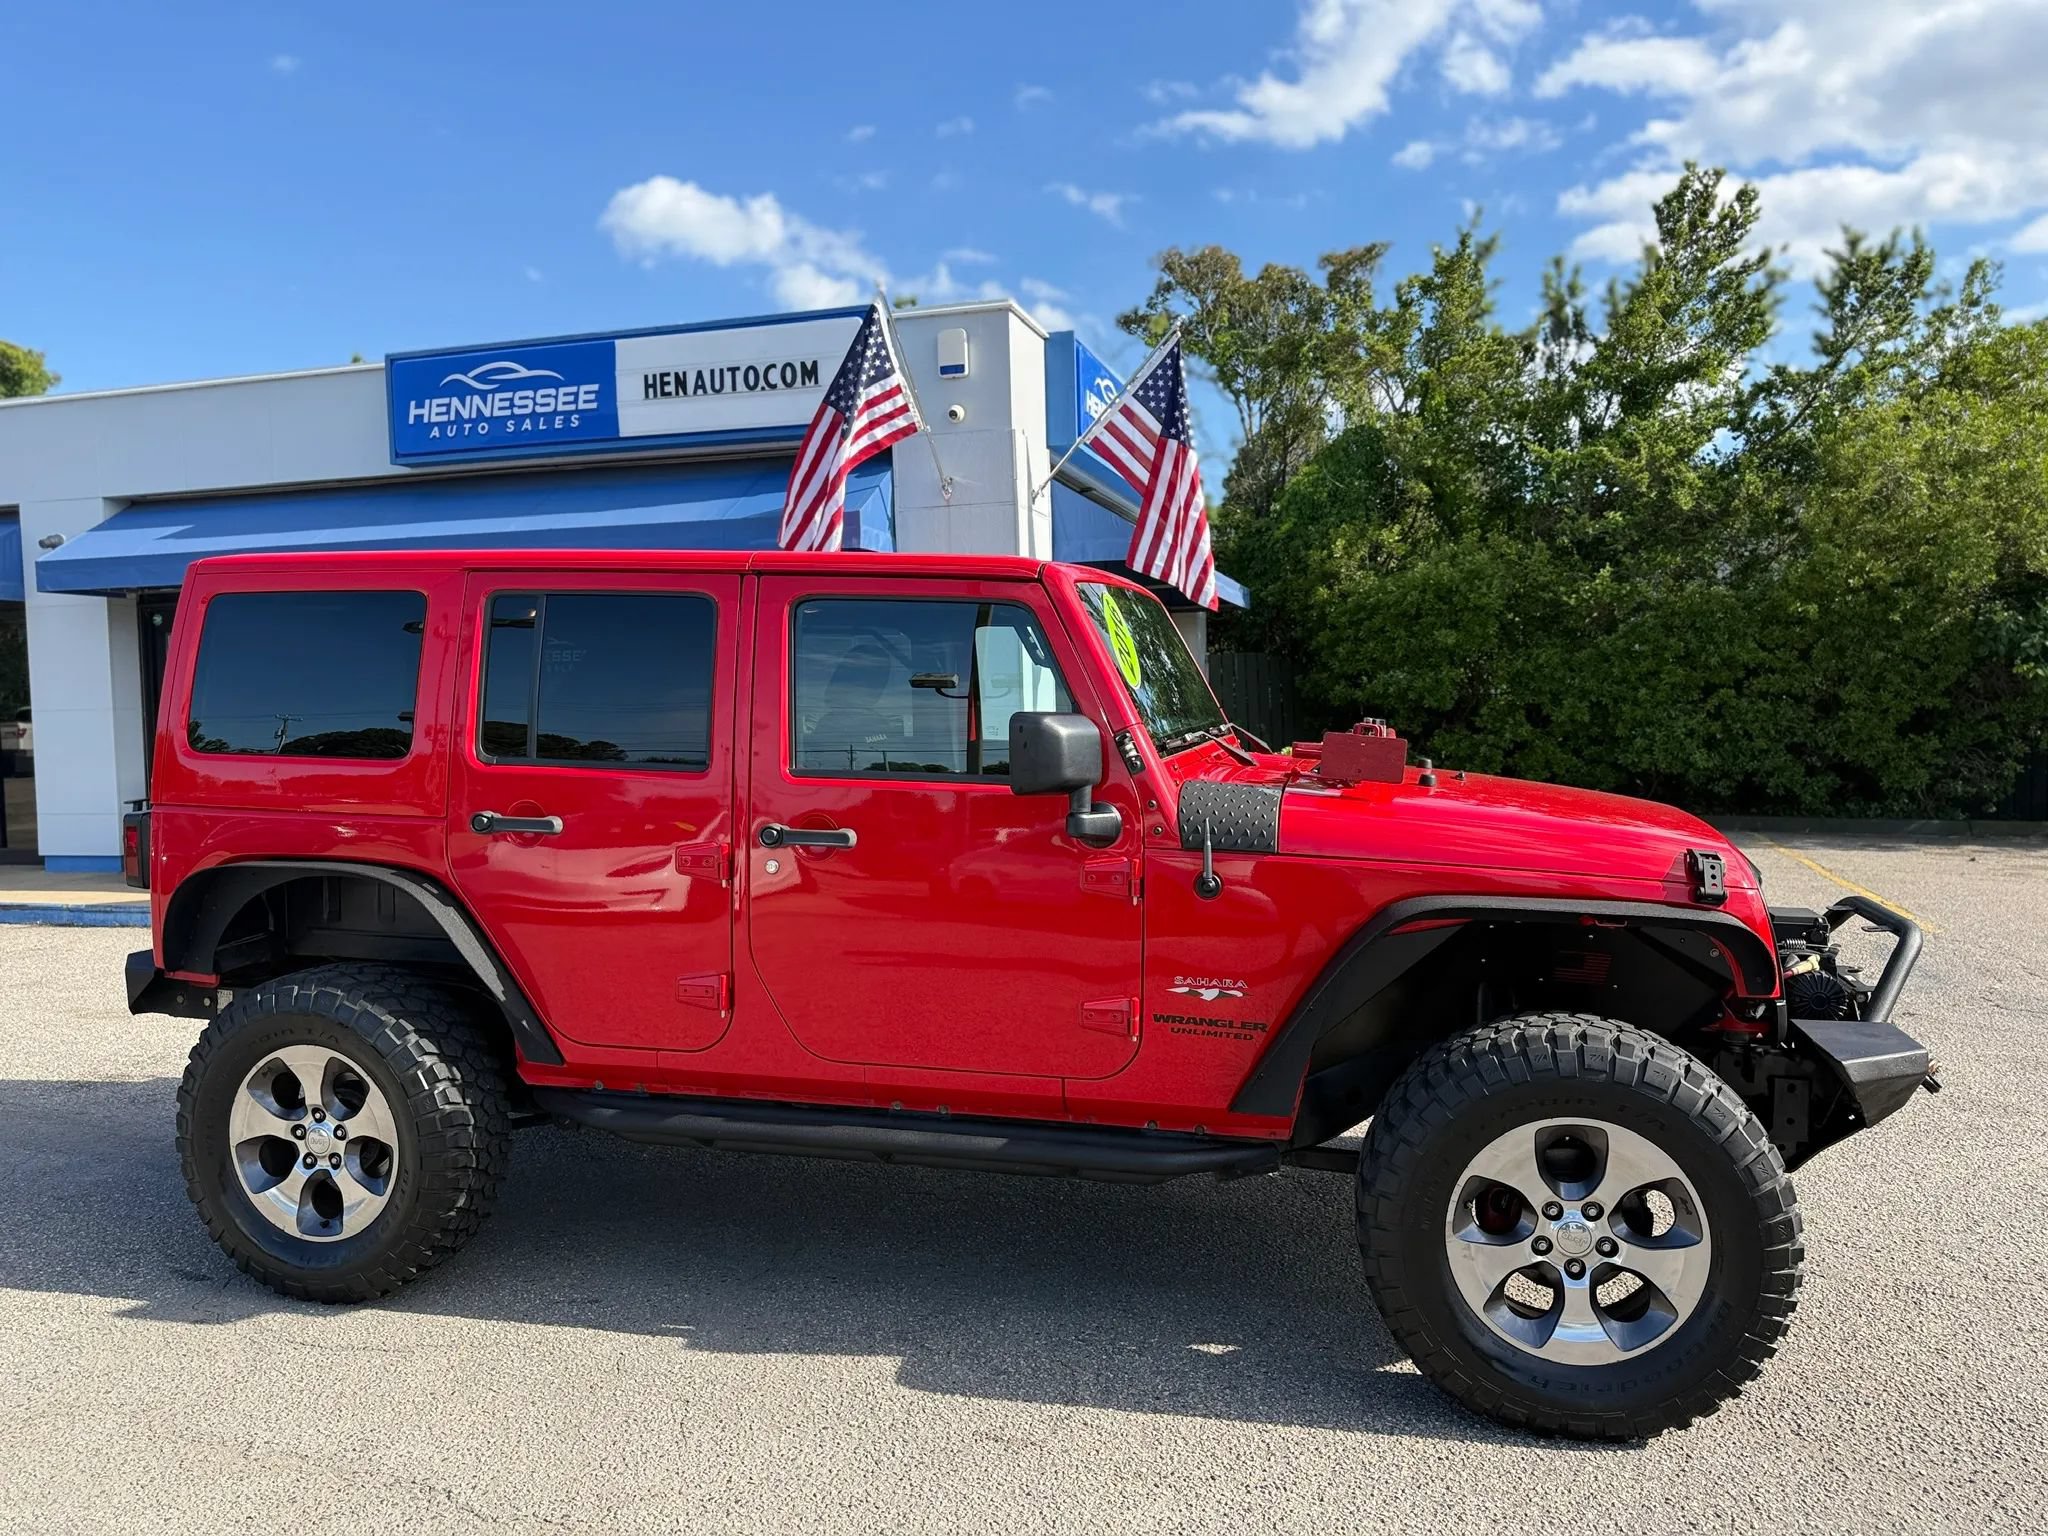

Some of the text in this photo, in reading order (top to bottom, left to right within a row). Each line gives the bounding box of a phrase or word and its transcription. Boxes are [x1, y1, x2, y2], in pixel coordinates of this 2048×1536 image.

[408, 383, 600, 425] HENNESSEE
[429, 414, 581, 439] AUTO SALES
[1173, 975, 1248, 989] SAHARA
[1152, 1013, 1268, 1032] WRANGLER
[1170, 1027, 1254, 1041] UNLIMITED
